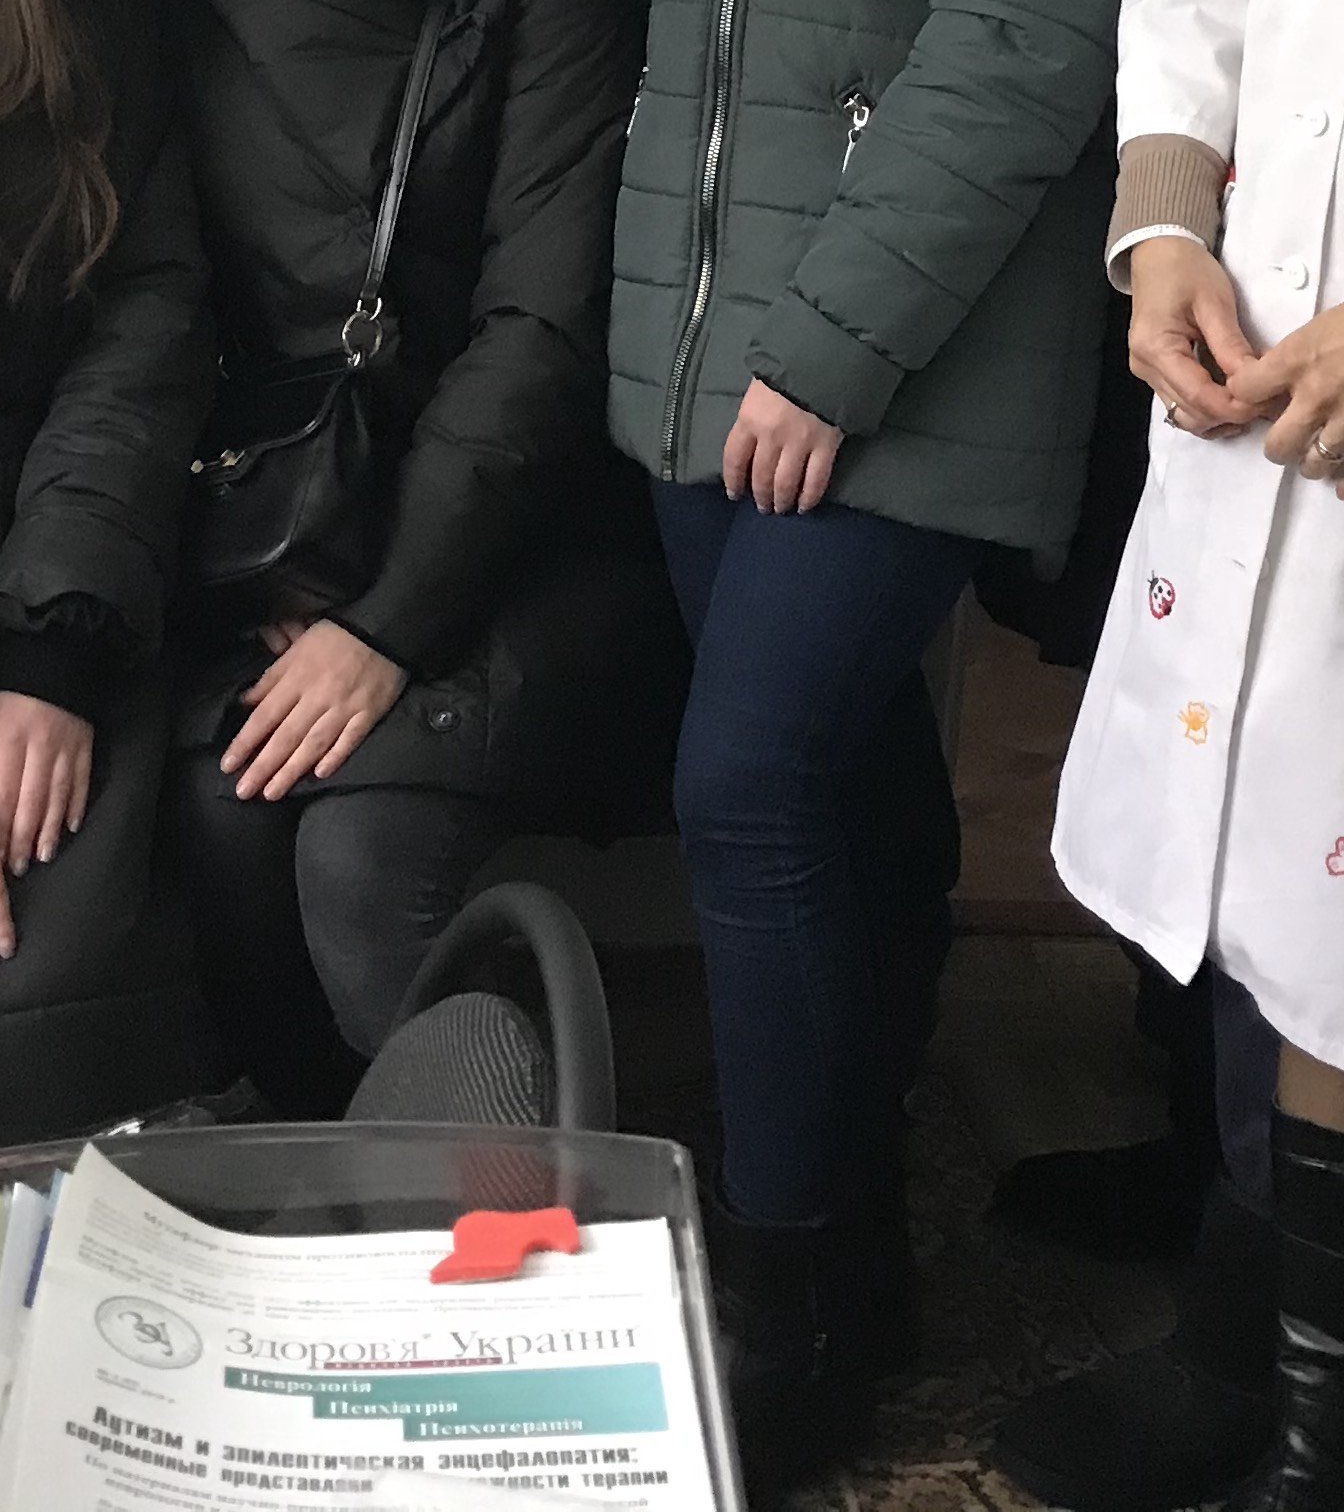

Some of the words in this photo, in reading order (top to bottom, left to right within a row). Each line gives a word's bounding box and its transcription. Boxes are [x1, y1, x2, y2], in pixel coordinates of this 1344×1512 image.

[450, 1325, 641, 1365] України
[240, 1372, 372, 1393] Неврологія
[330, 1400, 458, 1416] Психіатрія
[93, 1405, 184, 1450] Аутизм
[195, 1440, 210, 1456] и
[223, 1445, 425, 1471] эпилептическая
[419, 1418, 584, 1437] Психотерапія
[65, 1420, 208, 1479] современные
[582, 1470, 669, 1490] терапии
